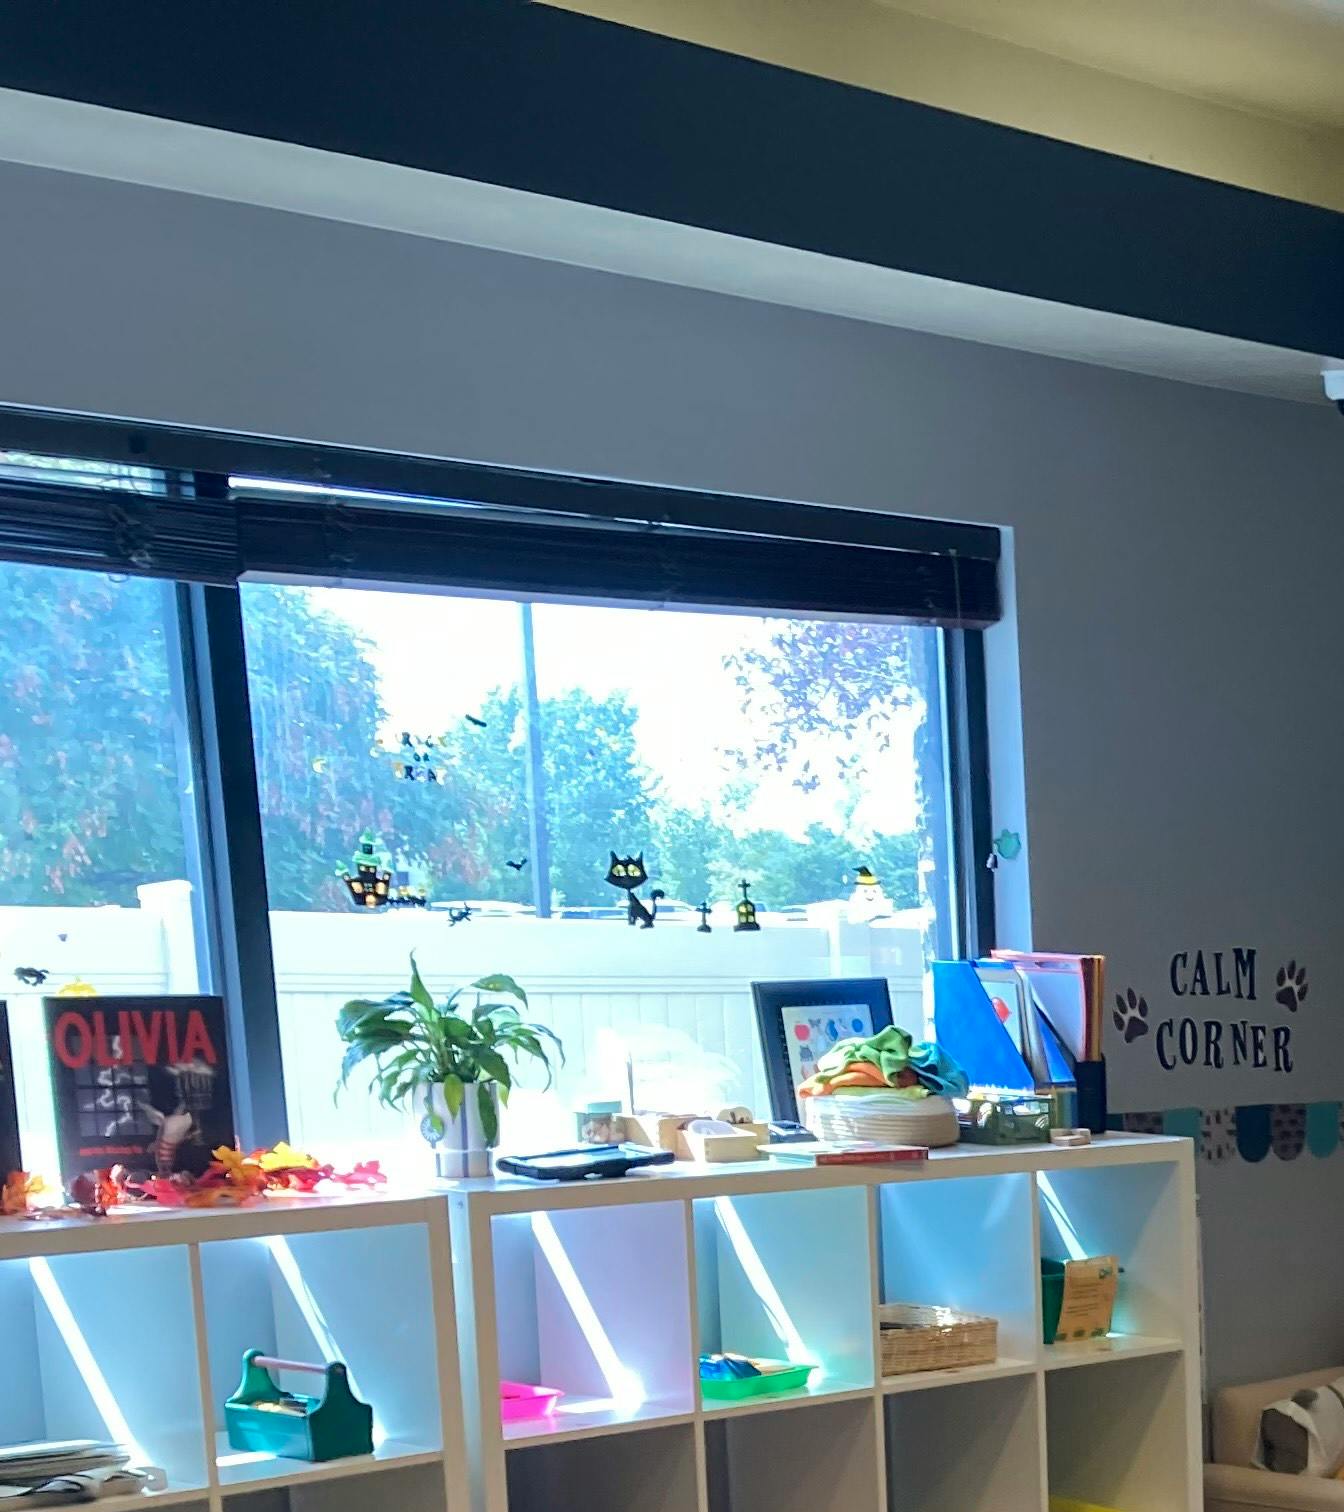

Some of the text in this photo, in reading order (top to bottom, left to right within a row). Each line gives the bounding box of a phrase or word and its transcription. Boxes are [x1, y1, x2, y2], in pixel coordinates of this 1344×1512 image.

[1170, 947, 1257, 1000] CALM
[54, 1009, 217, 1069] OLIVIA
[1156, 1018, 1293, 1073] CORNER
